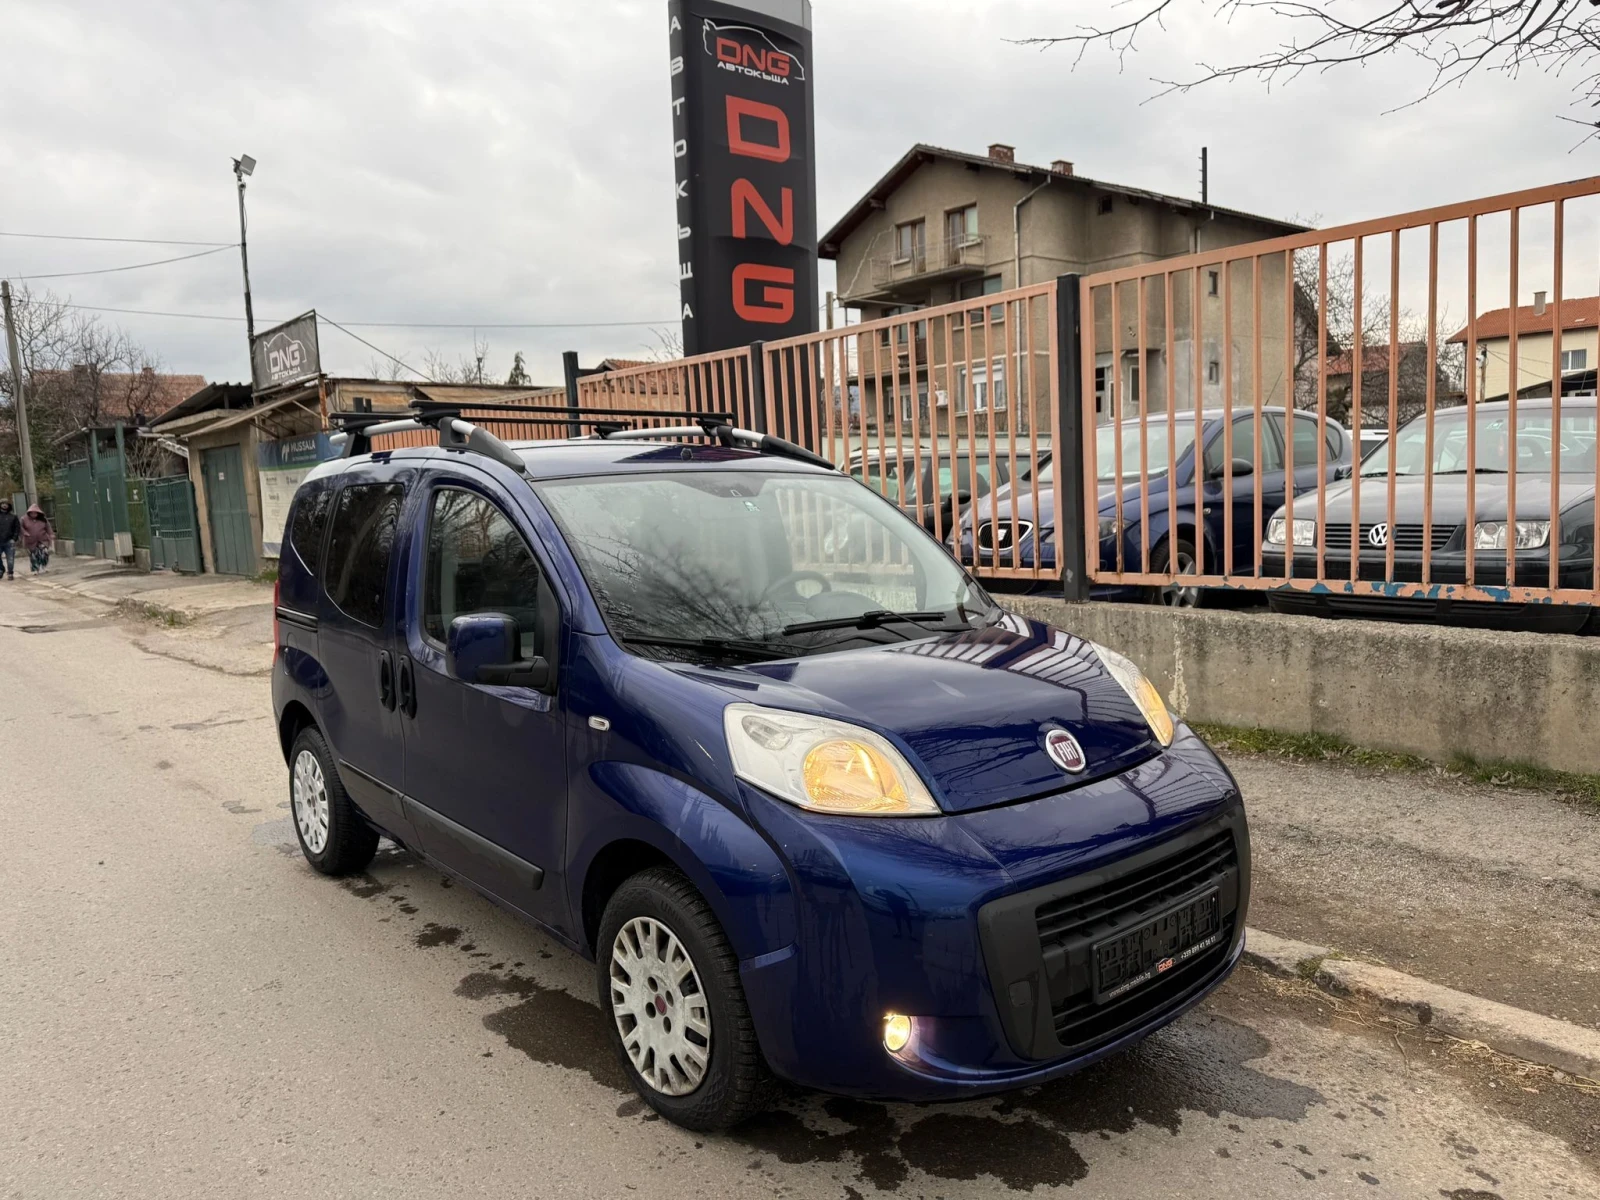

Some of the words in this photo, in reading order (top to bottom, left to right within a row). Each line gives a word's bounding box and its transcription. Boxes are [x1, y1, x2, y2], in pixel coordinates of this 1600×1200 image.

[716, 36, 790, 77] DNG
[725, 94, 794, 324] DNG
[269, 343, 300, 373] DNG
[290, 440, 316, 453] MUSSALA
[1054, 740, 1079, 762] FIAT
